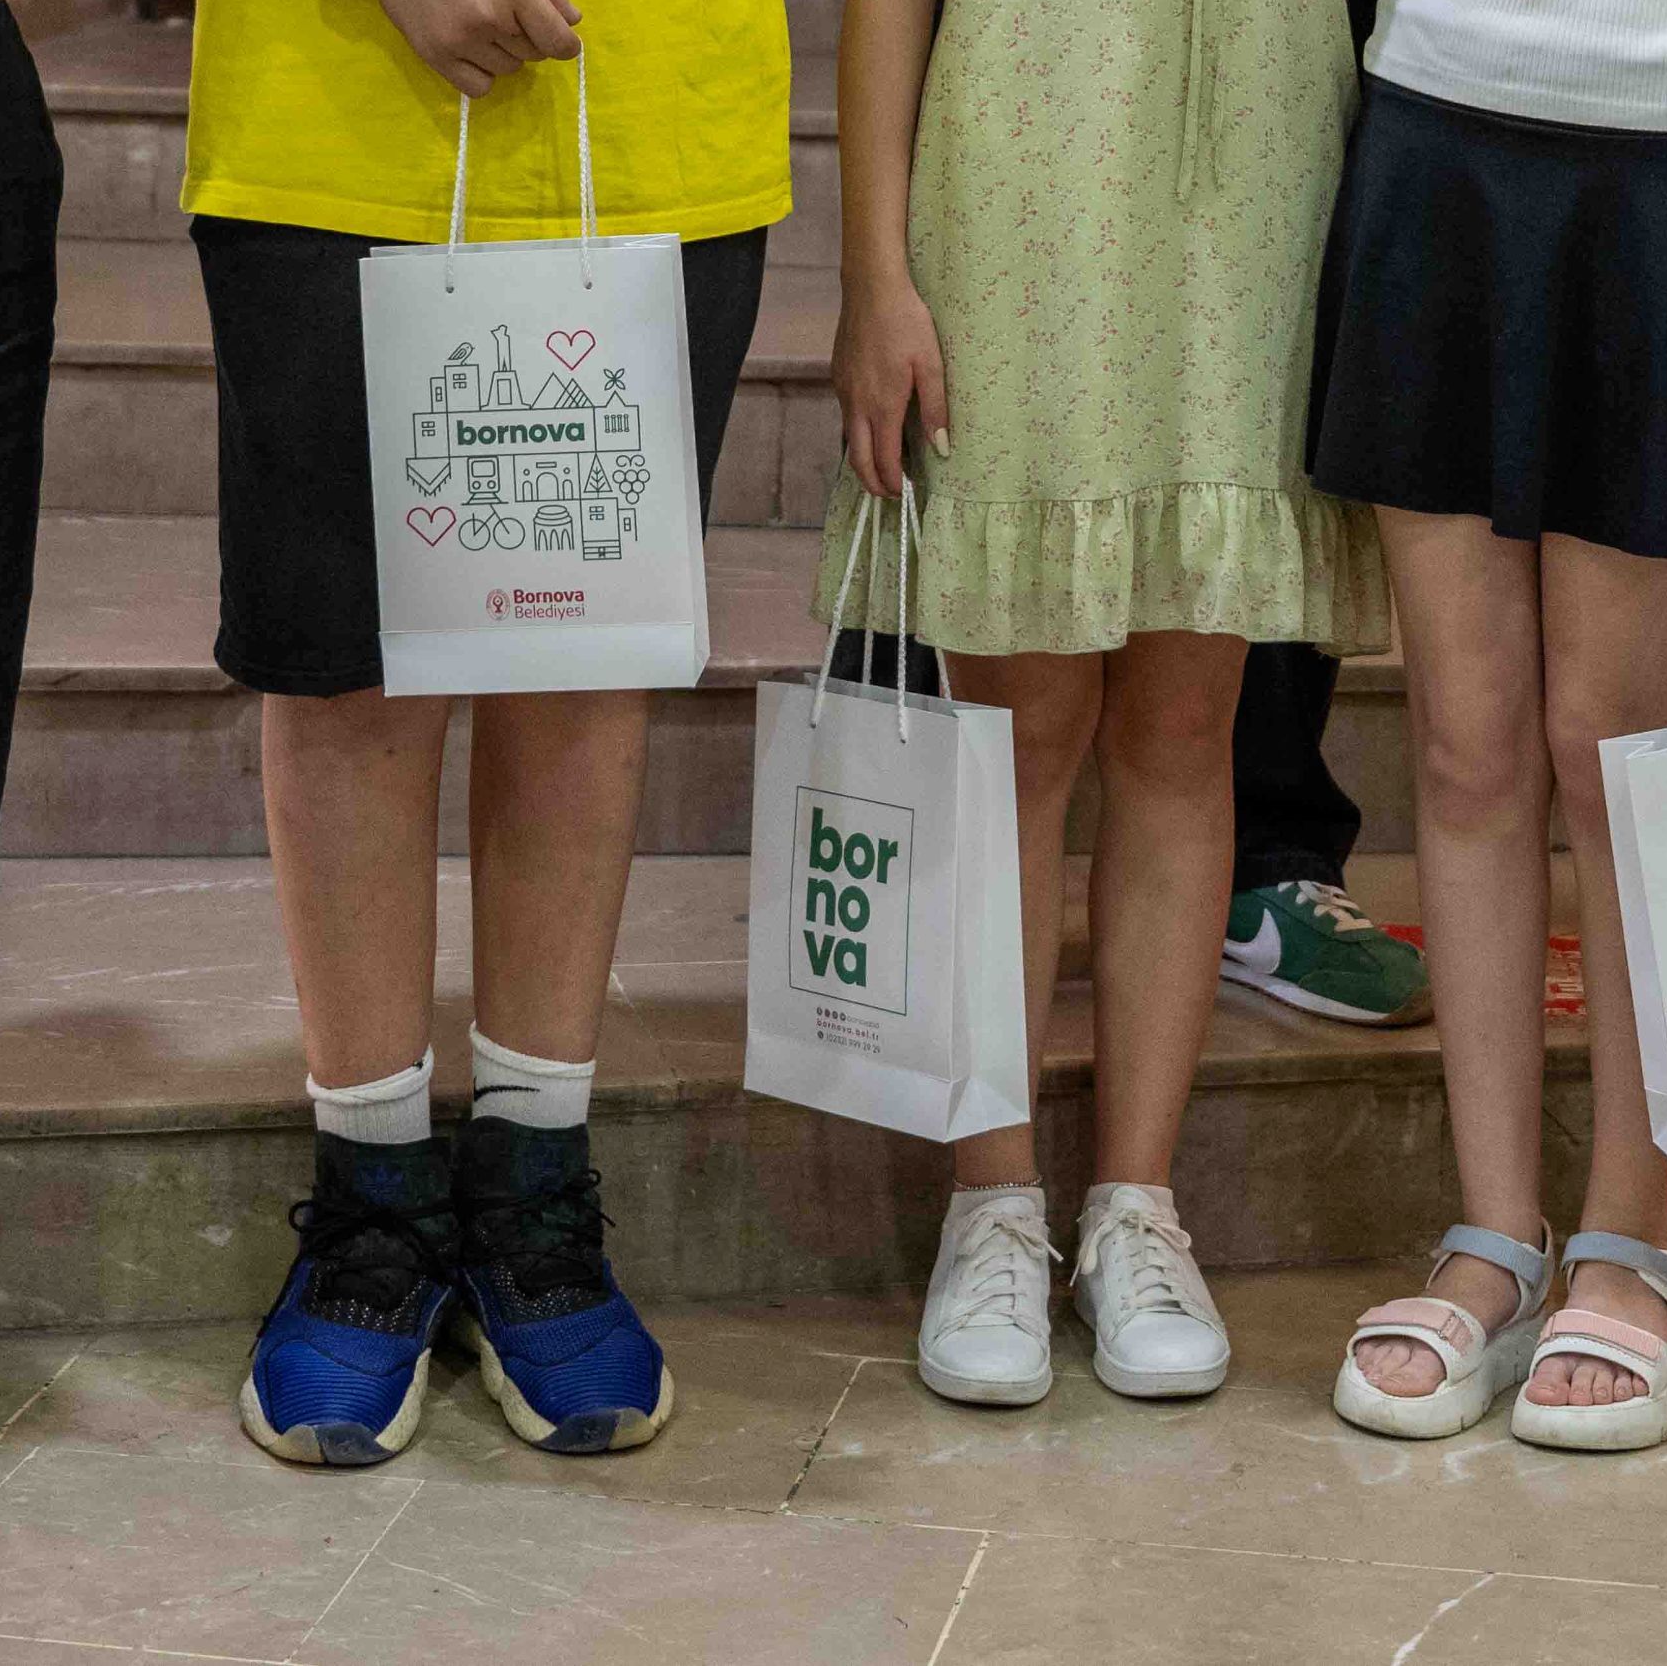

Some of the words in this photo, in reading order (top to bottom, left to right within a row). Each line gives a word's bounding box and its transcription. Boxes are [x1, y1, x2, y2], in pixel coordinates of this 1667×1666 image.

[456, 419, 586, 446] bornova
[513, 588, 585, 604] Bornova
[514, 603, 586, 621] Belediyesi
[808, 806, 899, 885] bor
[805, 876, 871, 933] no
[802, 929, 868, 988] va
